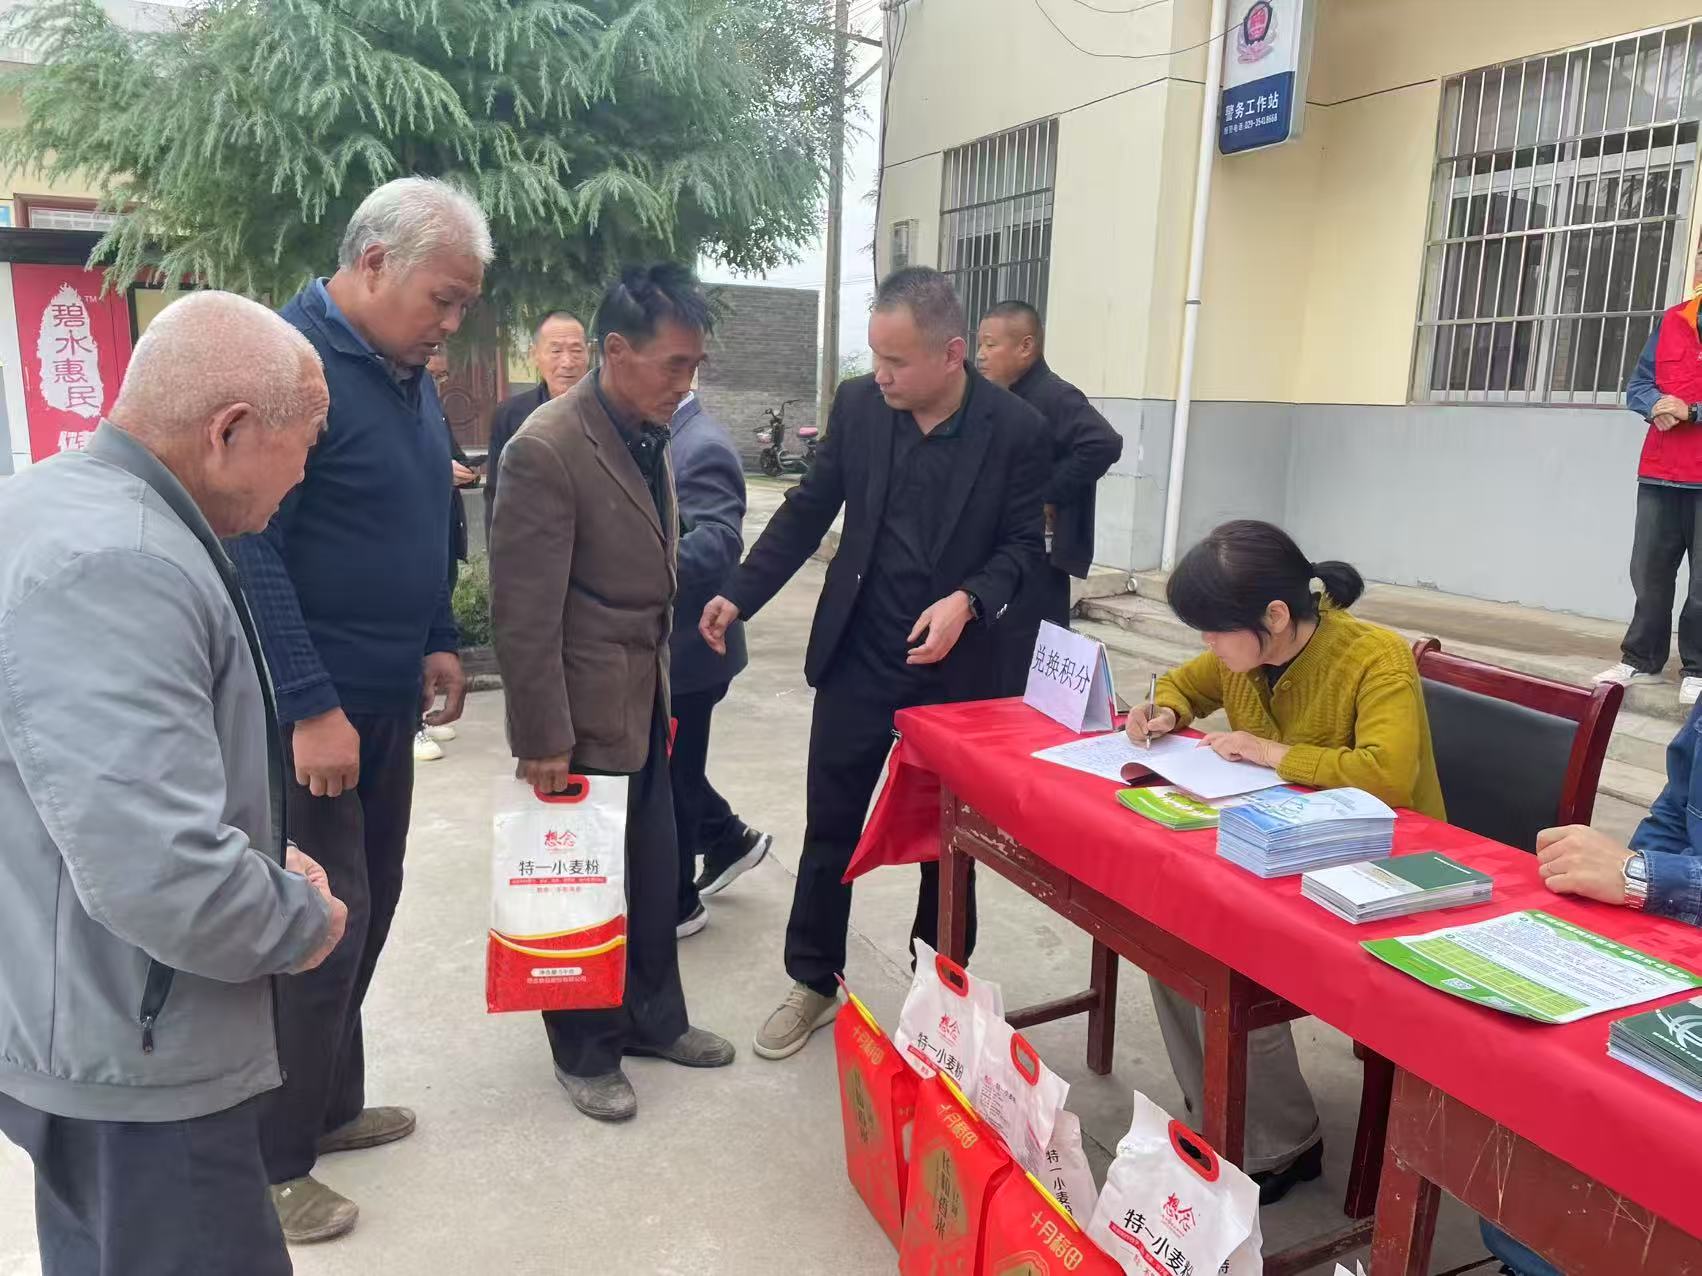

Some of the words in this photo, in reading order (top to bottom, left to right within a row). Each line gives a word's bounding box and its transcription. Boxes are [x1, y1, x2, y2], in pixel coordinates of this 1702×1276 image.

[1225, 91, 1279, 121] 警务工作站
[51, 303, 99, 409] 碧水惠民
[1032, 644, 1090, 693] 兑换积分
[544, 829, 577, 848] 想念
[519, 859, 600, 877] 特一小麦粉
[917, 1032, 964, 1080] 特一小麦粉
[937, 1103, 979, 1149] 十月稻田
[1163, 1191, 1196, 1232] 想念
[1030, 1210, 1084, 1271] 十月稻田
